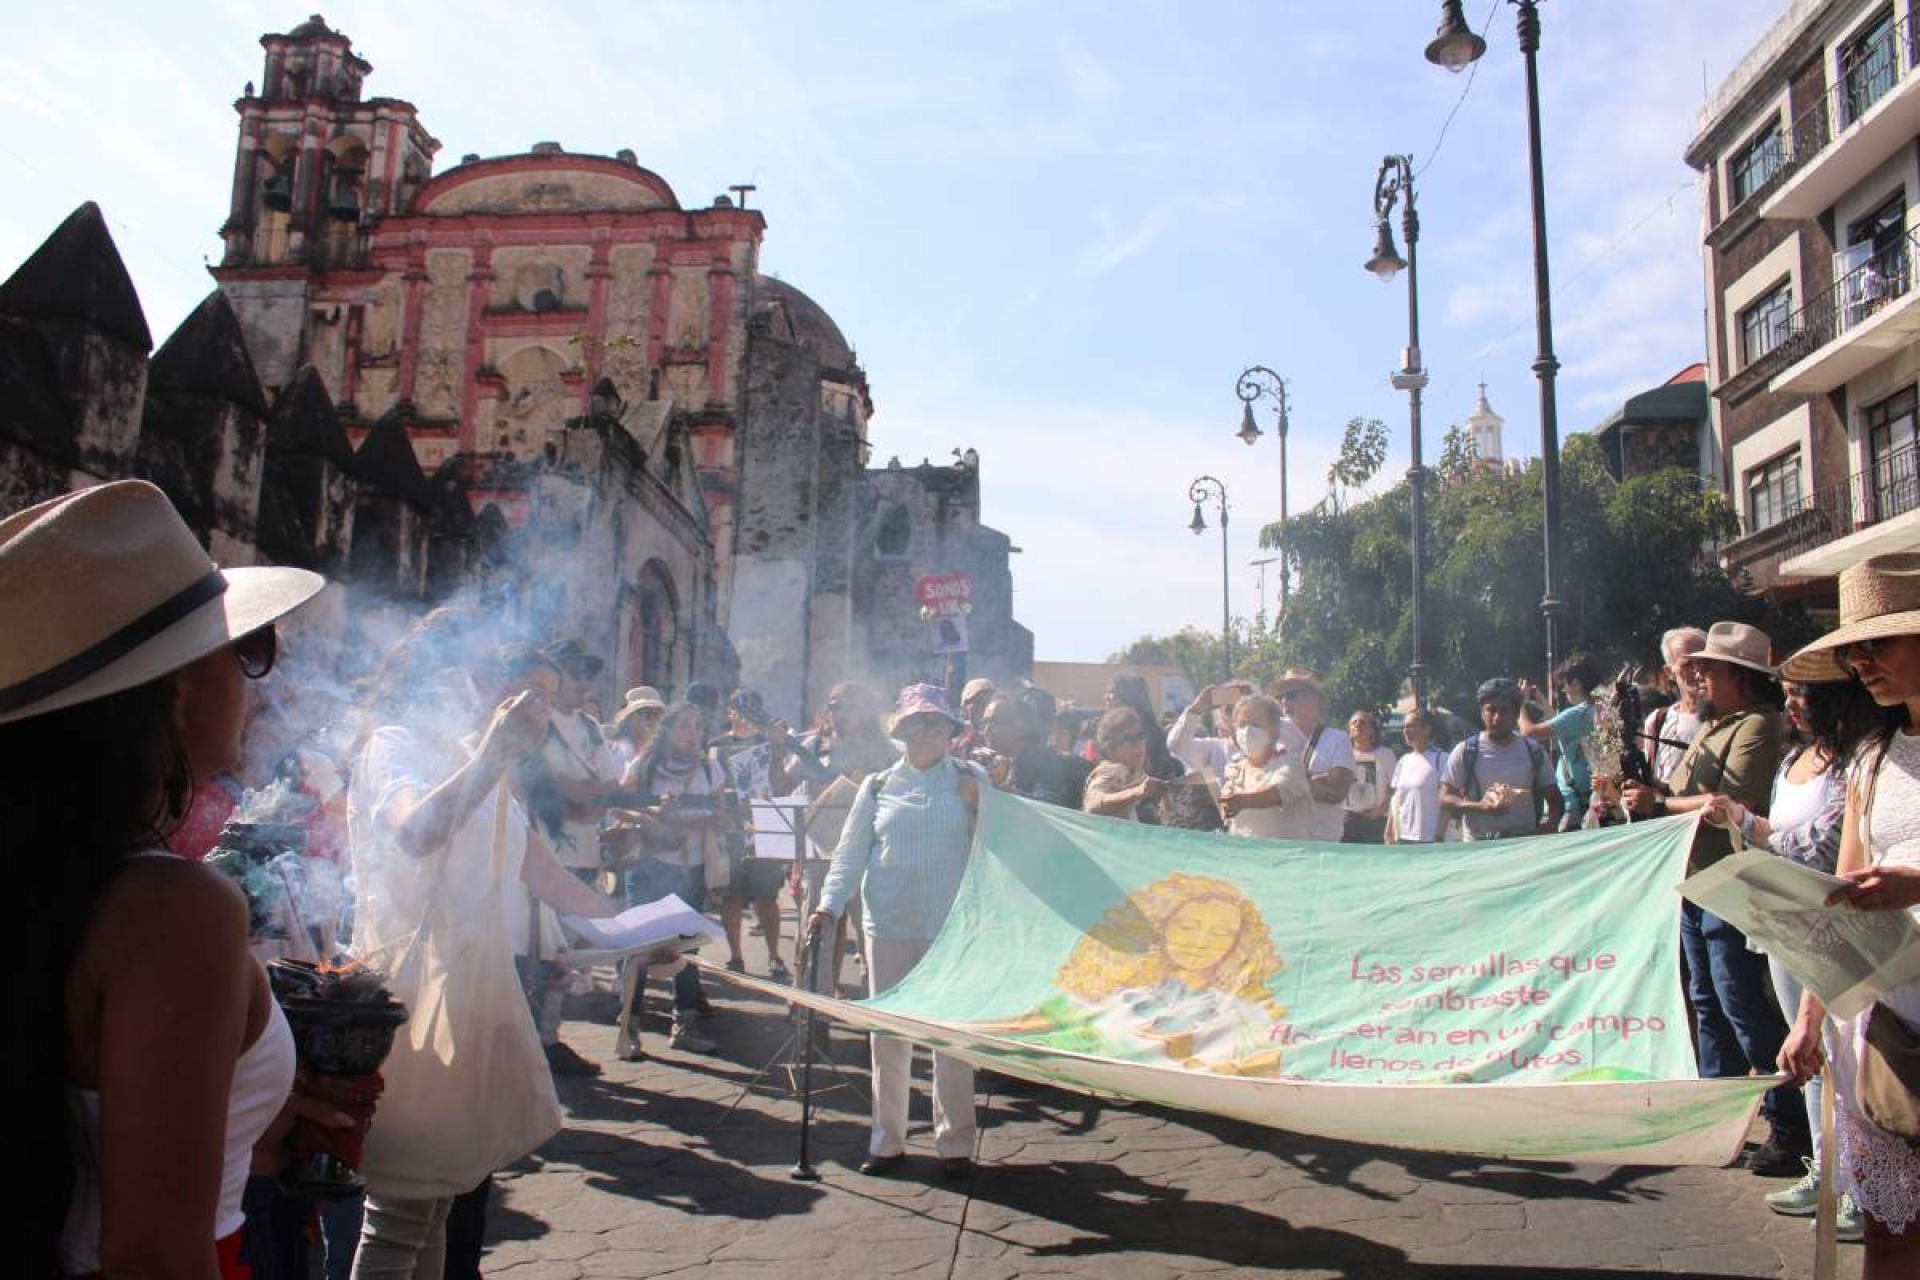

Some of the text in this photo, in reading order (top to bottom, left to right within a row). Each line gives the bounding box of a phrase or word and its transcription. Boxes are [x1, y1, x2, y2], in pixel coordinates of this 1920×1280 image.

[1352, 954, 1402, 984] Las
[1551, 952, 1616, 980] que
[1446, 1028, 1490, 1045] en
[1550, 1013, 1665, 1043] campo
[1330, 1047, 1425, 1071] llenos
